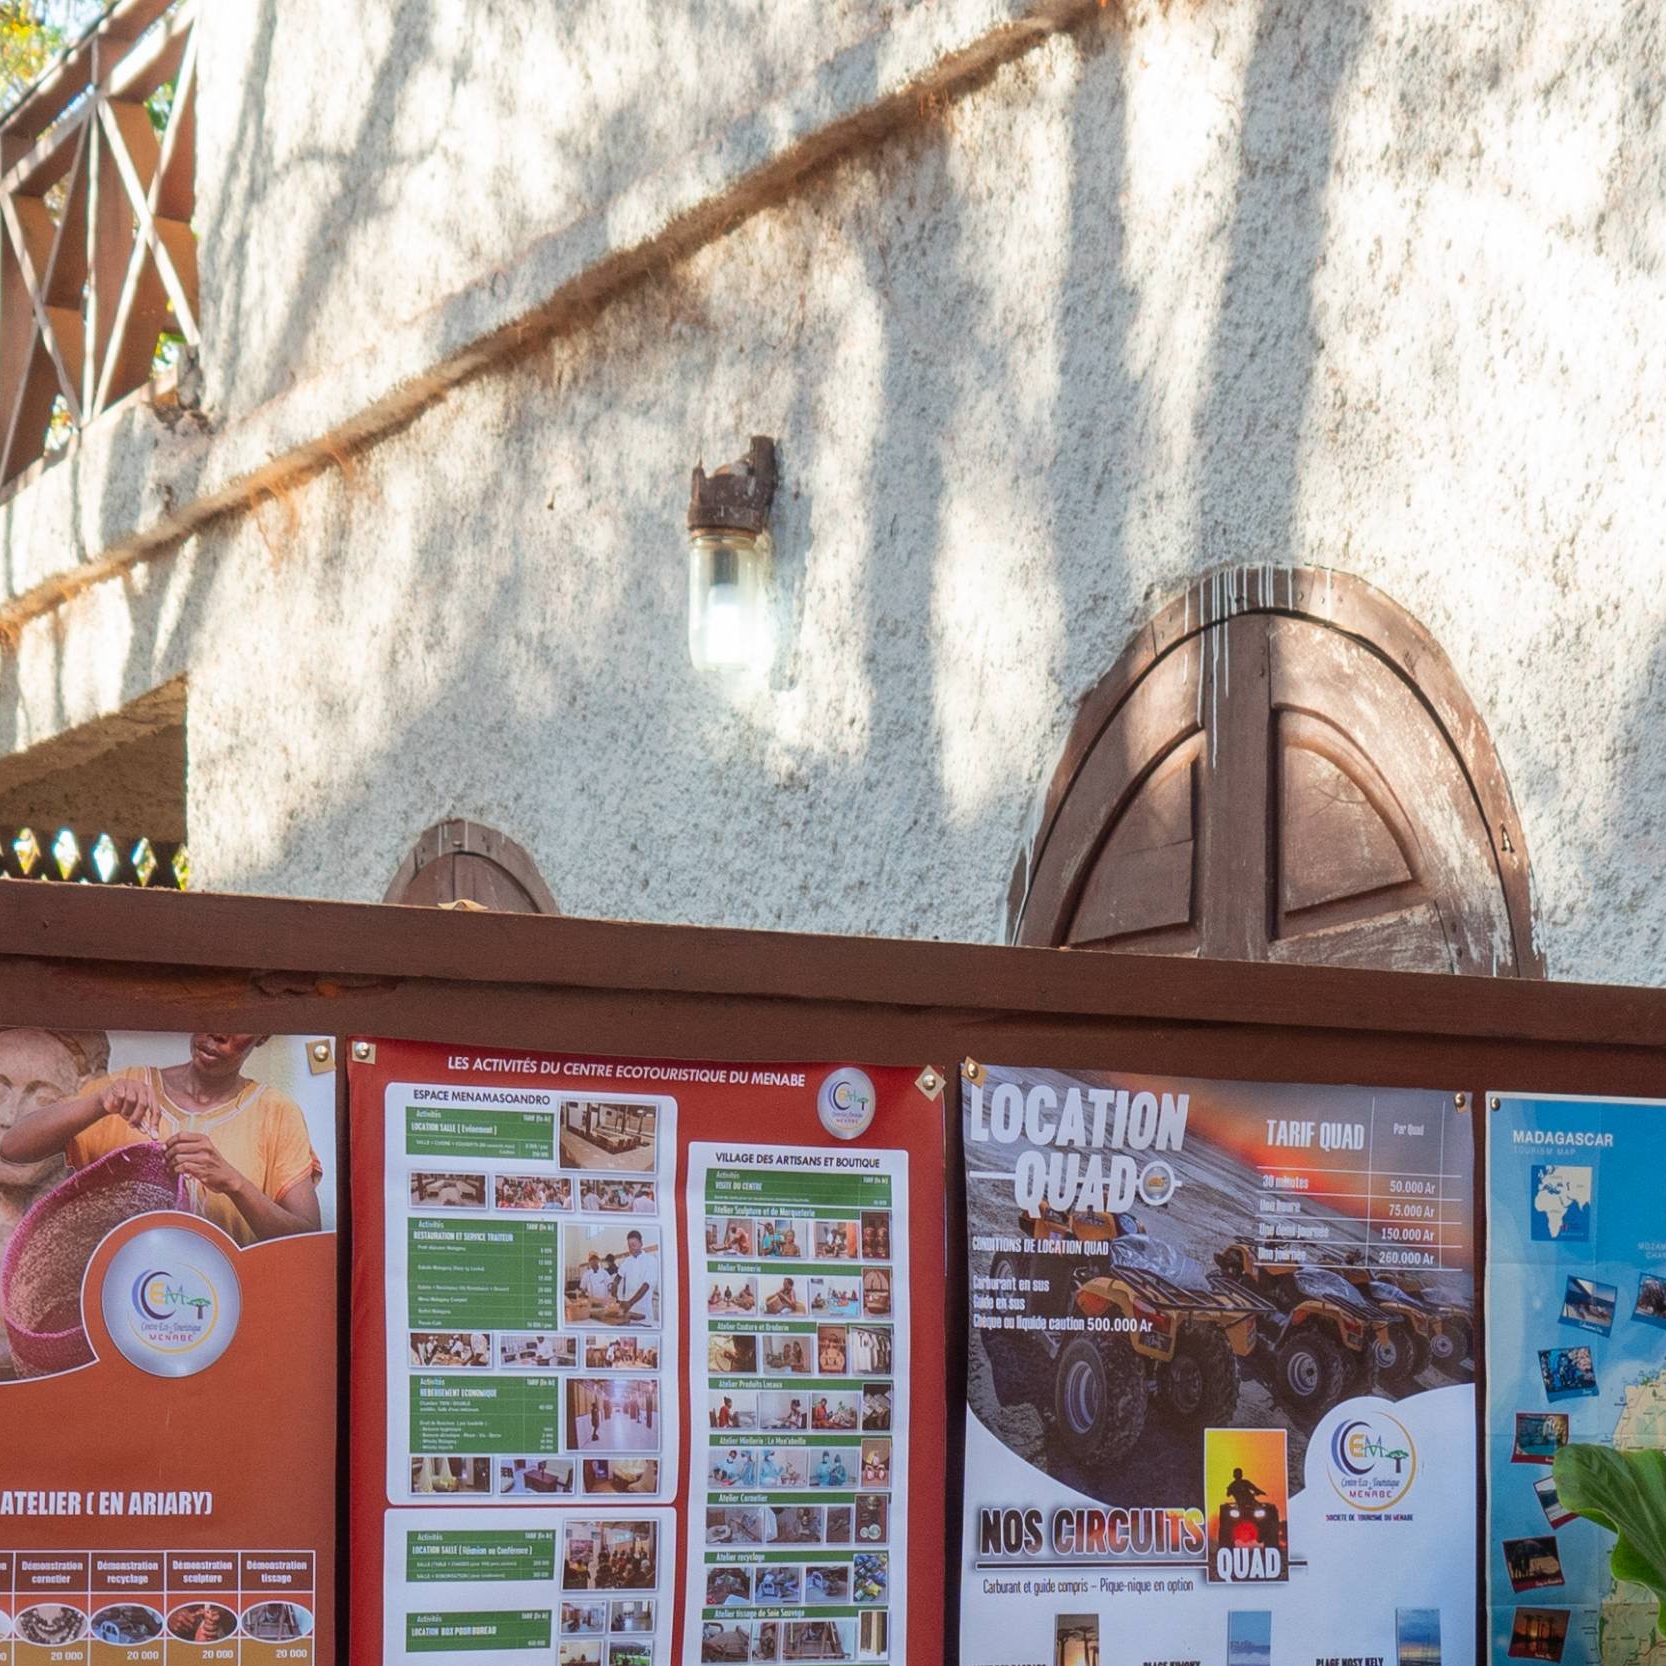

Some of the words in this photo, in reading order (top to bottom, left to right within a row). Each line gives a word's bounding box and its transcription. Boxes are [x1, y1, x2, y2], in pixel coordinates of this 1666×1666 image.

[448, 1056, 468, 1069] LES
[472, 1058, 536, 1073] ACTIVITÉS
[540, 1061, 560, 1074] DU
[563, 1062, 613, 1076] CENTRE
[616, 1065, 726, 1082] ECOTOURISTIQUE
[729, 1071, 748, 1084] DU
[751, 1072, 805, 1086] MENABE
[413, 1089, 448, 1100] ESPACE
[451, 1091, 550, 1105] MENAMASOANDRO
[969, 1083, 1190, 1152] LOCATION
[1267, 1120, 1315, 1146] TARIF
[1320, 1122, 1364, 1151] QUAD
[1512, 1130, 1614, 1147] MADAGASCAR
[715, 1152, 753, 1163] VILLAGE
[756, 1154, 773, 1164] DES
[775, 1155, 821, 1166] ARTISANS
[823, 1157, 834, 1166] ET
[836, 1157, 879, 1168] BOUTIQUE
[1015, 1151, 1137, 1218] QUAD
[1389, 1180, 1423, 1193] 50.000
[1424, 1182, 1435, 1194] Ar
[0, 1491, 81, 1514] ATELIER
[99, 1492, 123, 1514] EN
[128, 1491, 212, 1515] ARIARY)
[980, 1509, 1044, 1555] NOS
[1053, 1507, 1206, 1555] CIRCUITS
[1217, 1547, 1282, 1579] QUAD
[983, 1579, 1021, 1593] Carburant
[1023, 1581, 1031, 1593] et
[1033, 1578, 1055, 1596] guide
[1057, 1578, 1088, 1595] compris
[1100, 1577, 1151, 1595] Pique-nique
[1153, 1581, 1164, 1591] en
[1167, 1579, 1193, 1594] option
